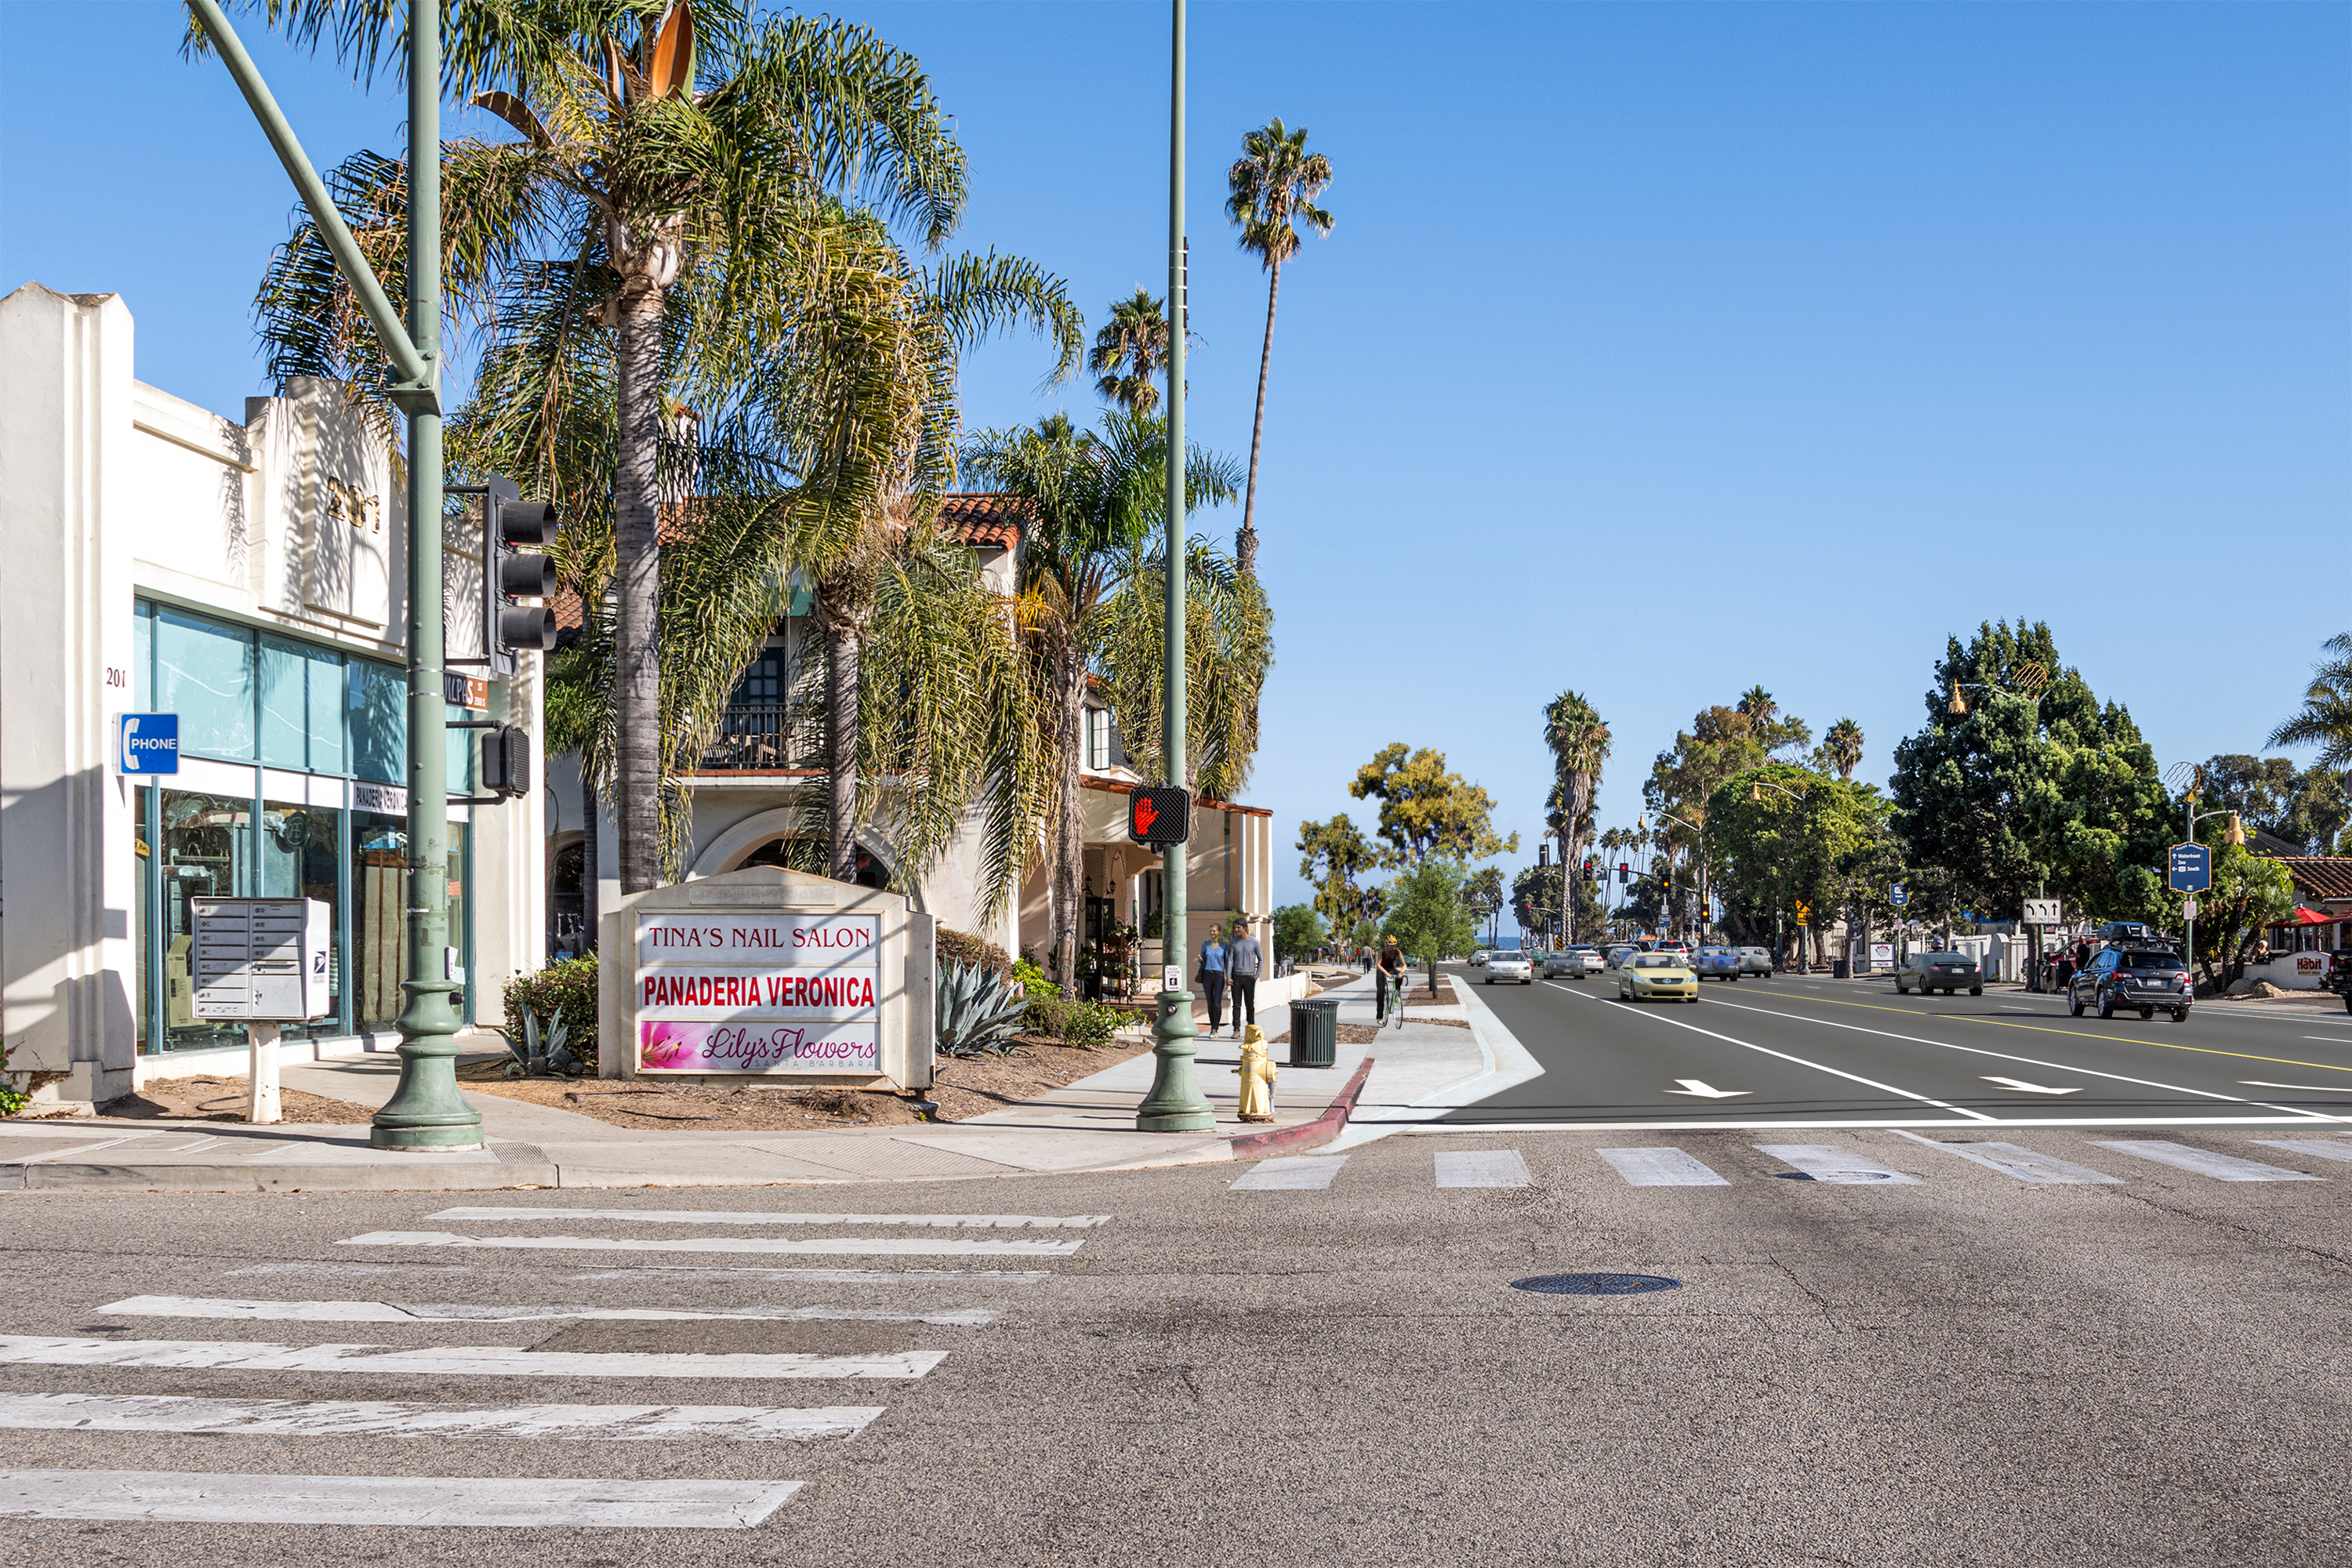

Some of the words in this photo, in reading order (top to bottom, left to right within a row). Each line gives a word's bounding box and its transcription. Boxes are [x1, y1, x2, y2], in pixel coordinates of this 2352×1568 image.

[327, 476, 379, 534] 201
[106, 667, 125, 688] 201
[131, 738, 177, 750] PHONE
[356, 786, 382, 808] PANADERIA
[648, 927, 724, 948] TINA'S
[731, 927, 785, 948] NAIL
[792, 927, 871, 948] SALON
[2297, 957, 2322, 970] Habit
[644, 976, 762, 1007] PANADERIA
[766, 977, 875, 1007] VERONICA
[702, 1027, 770, 1069] Lily's
[771, 1027, 877, 1059] Flowers
